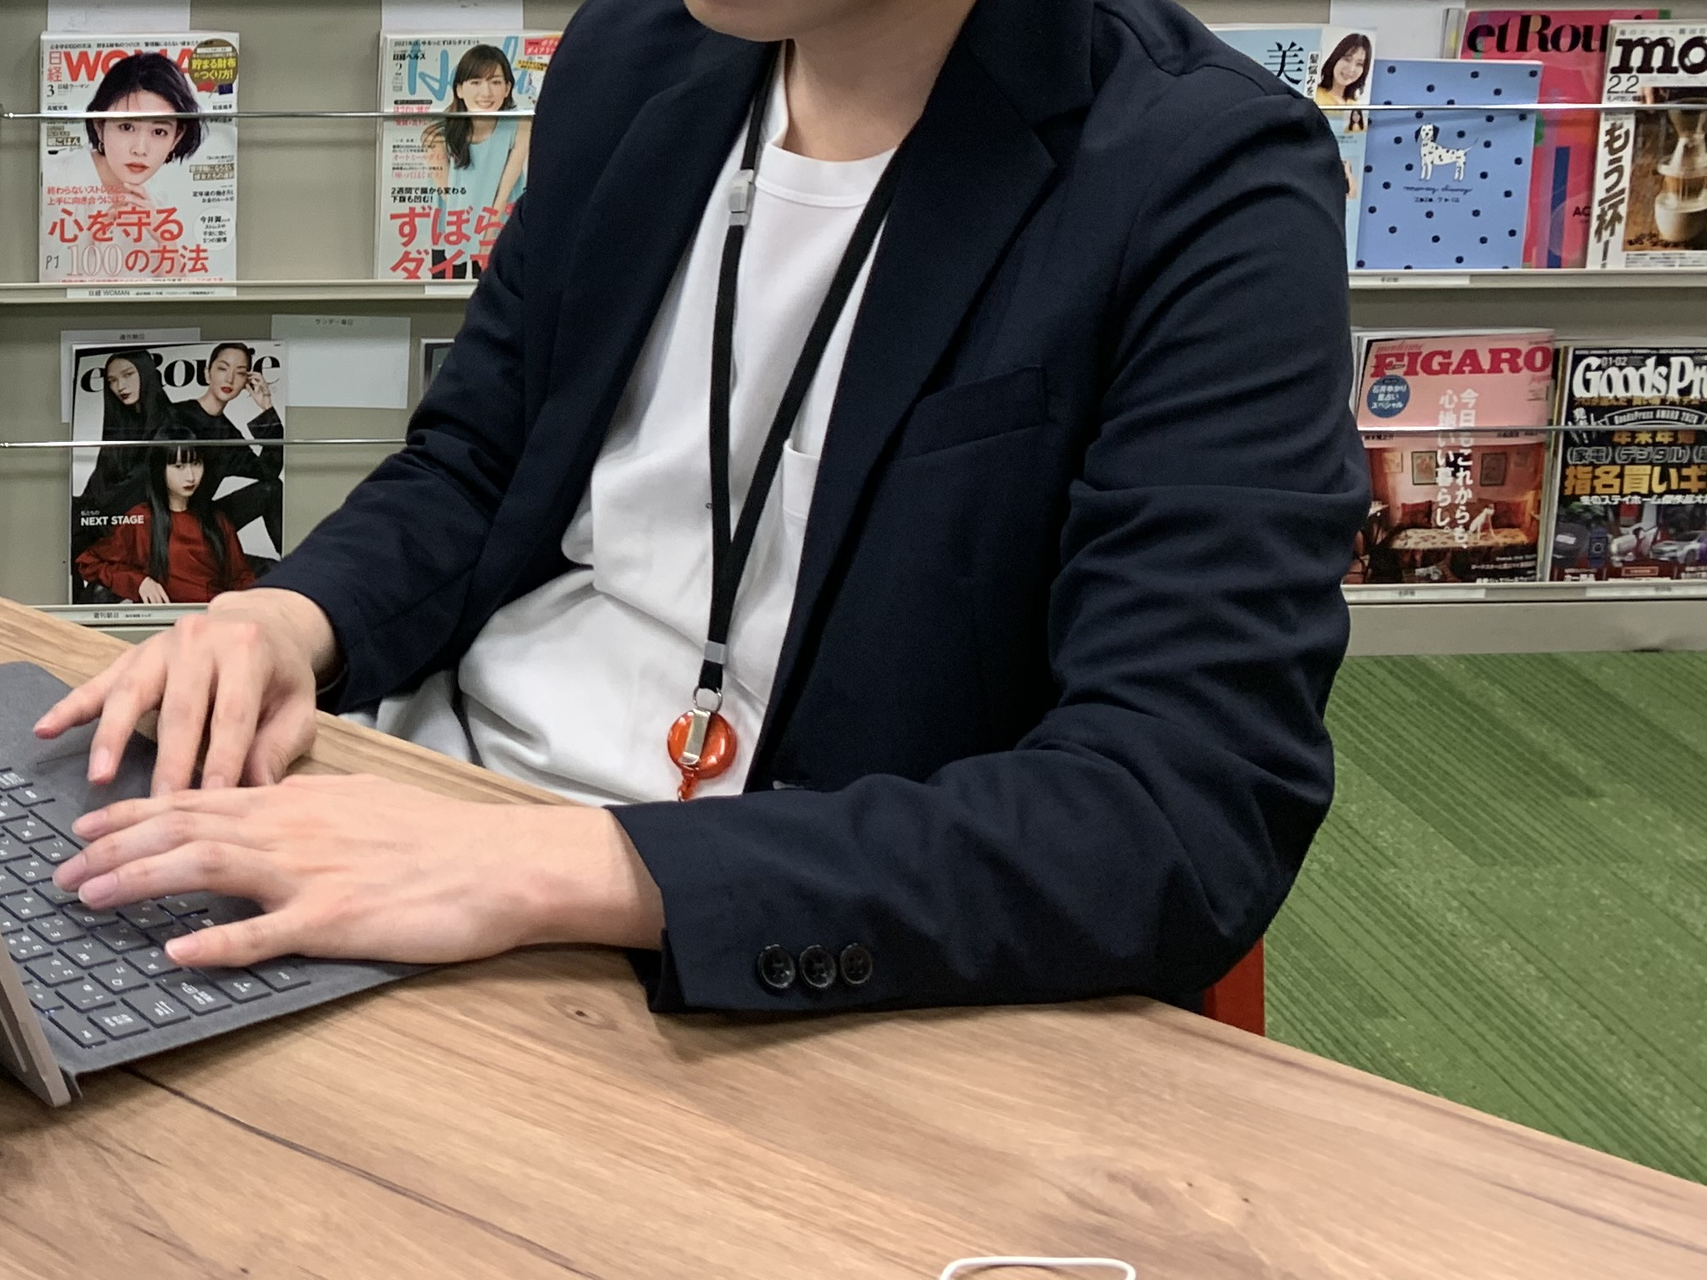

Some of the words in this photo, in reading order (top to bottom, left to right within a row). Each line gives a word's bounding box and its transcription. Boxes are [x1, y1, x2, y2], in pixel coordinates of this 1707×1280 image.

[393, 52, 426, 61] 日経ヘルス
[47, 51, 62, 83] 日経
[191, 59, 237, 70] 貯まる財布
[46, 84, 56, 97] 3
[57, 82, 90, 90] 日経ウーマン
[391, 186, 467, 195] 2週間で腸から変わる
[47, 195, 126, 206] 上手に向き合うには?
[391, 195, 434, 204] 下腹も凹む!
[49, 206, 184, 244] 心を守る
[46, 255, 60, 270] PJ
[68, 243, 210, 276] 100の方法
[88, 289, 102, 297] 日経
[103, 289, 130, 297] WOMAN
[1370, 346, 1551, 378] FIGARO
[1377, 393, 1399, 401] 星占い
[1371, 401, 1404, 410] スペシャル
[1567, 446, 1612, 464] (家電)
[1615, 446, 1691, 464] (デジタル)
[80, 515, 109, 527] NEXT
[111, 514, 144, 526] STAGE
